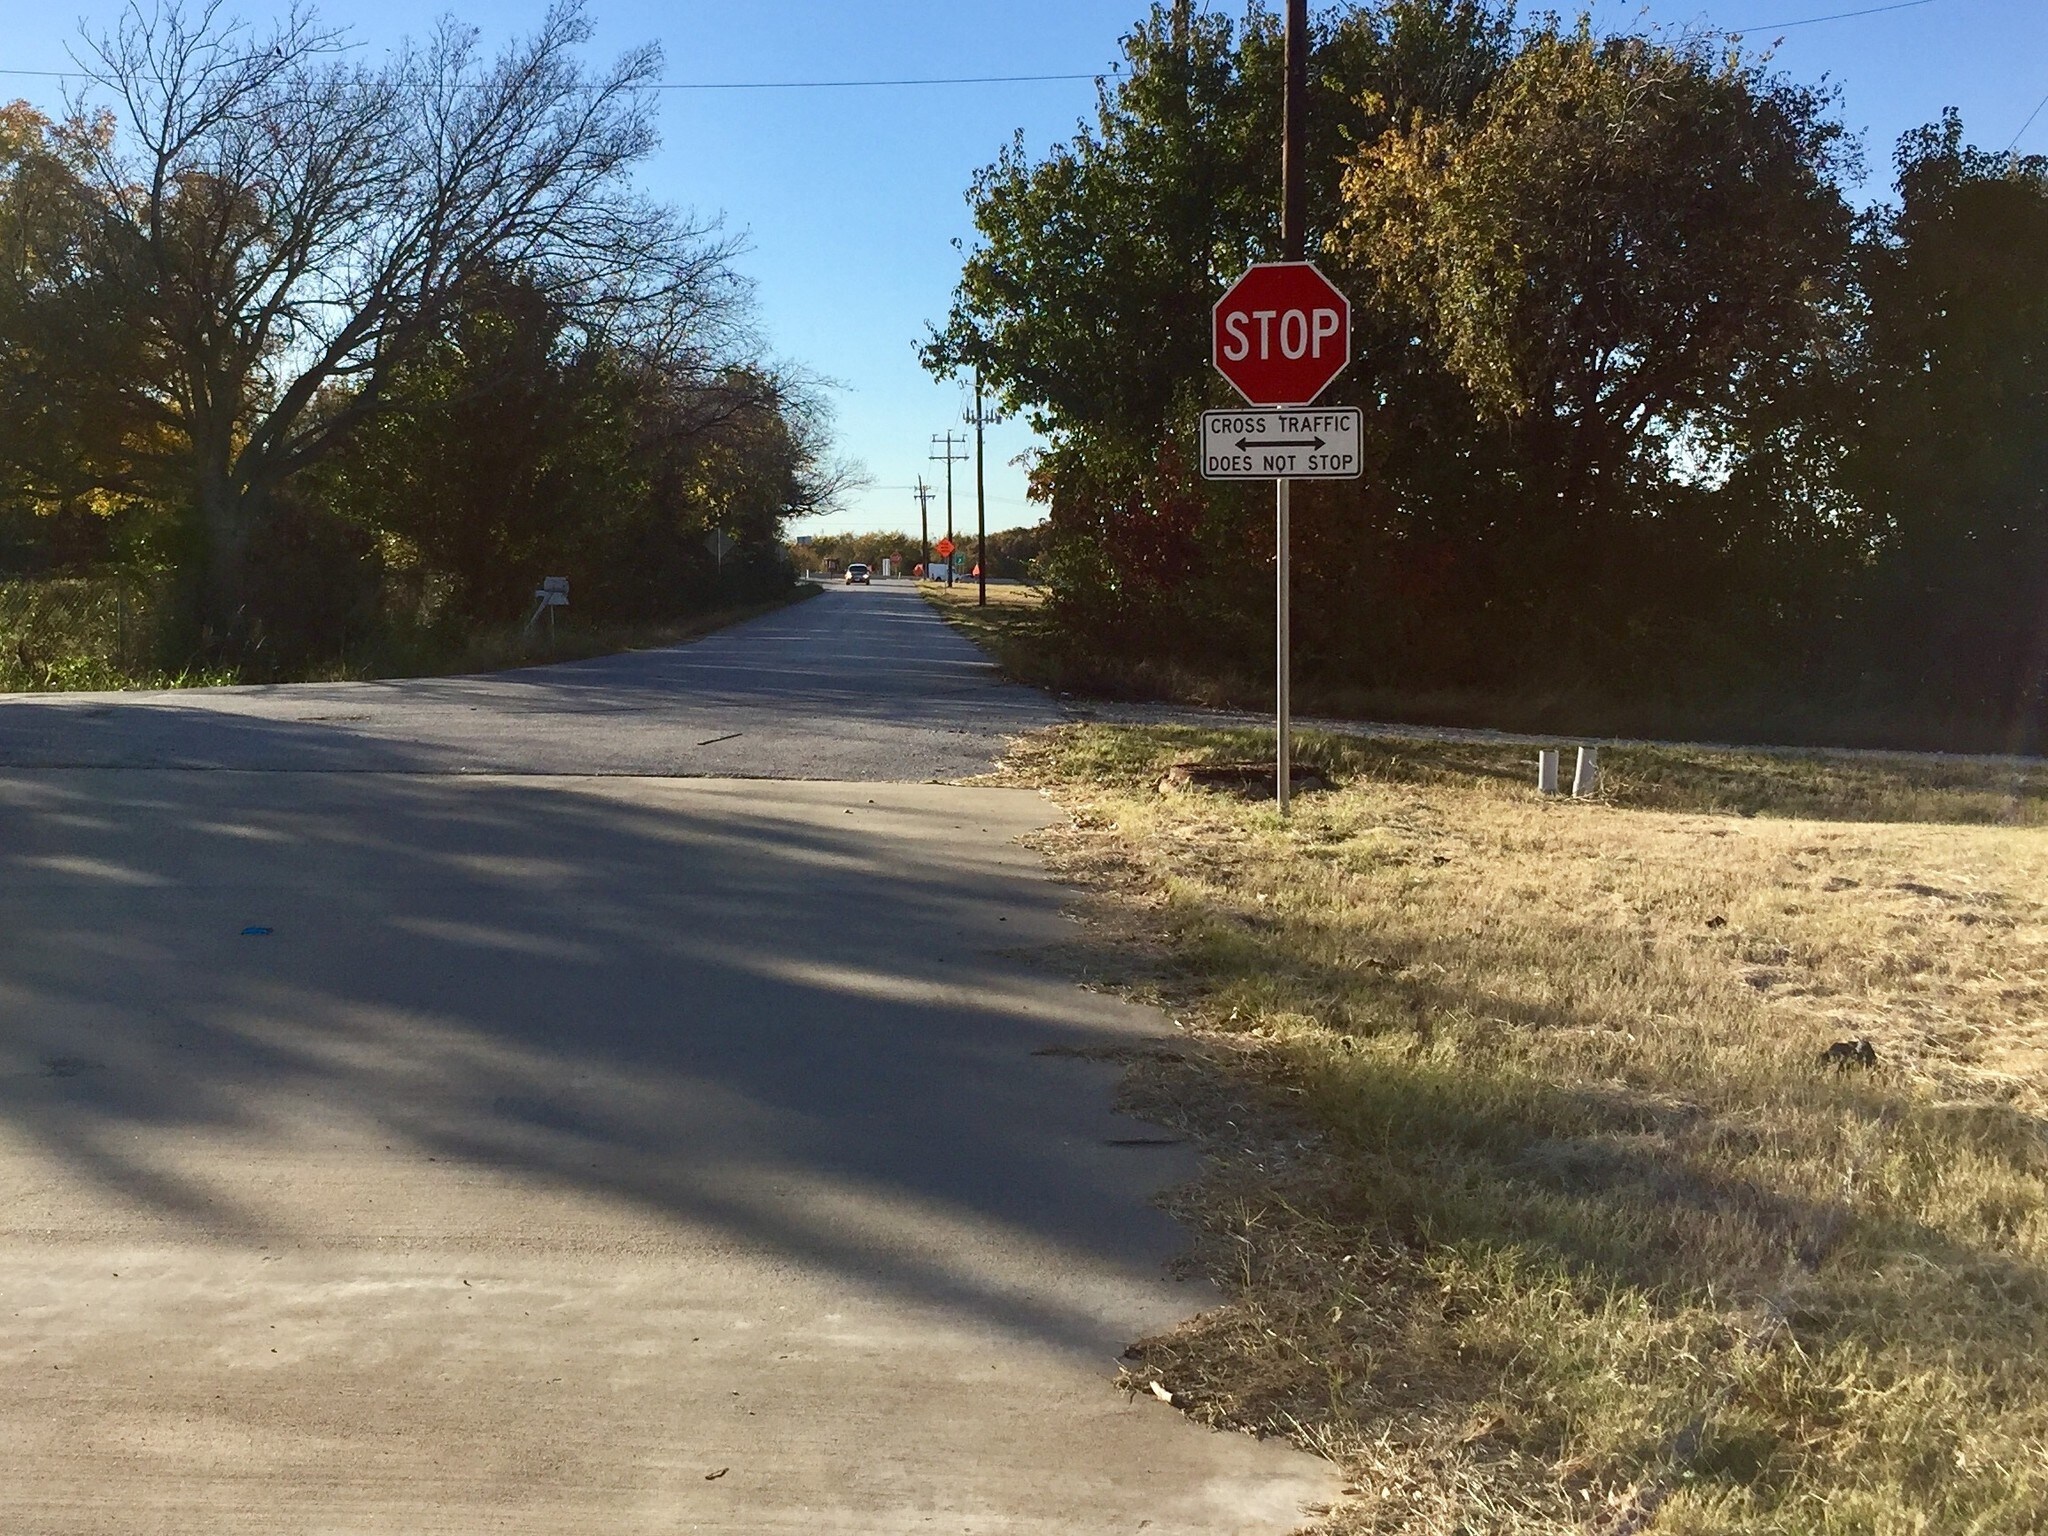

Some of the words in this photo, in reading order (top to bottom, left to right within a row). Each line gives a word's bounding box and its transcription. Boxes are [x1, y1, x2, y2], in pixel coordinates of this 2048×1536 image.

[1223, 308, 1340, 361] STOP
[1211, 418, 1266, 434] CROSS
[1279, 416, 1351, 432] TRAFFIC
[1209, 456, 1252, 471] DOES
[1263, 455, 1296, 471] NOT
[1308, 455, 1353, 470] STOP
